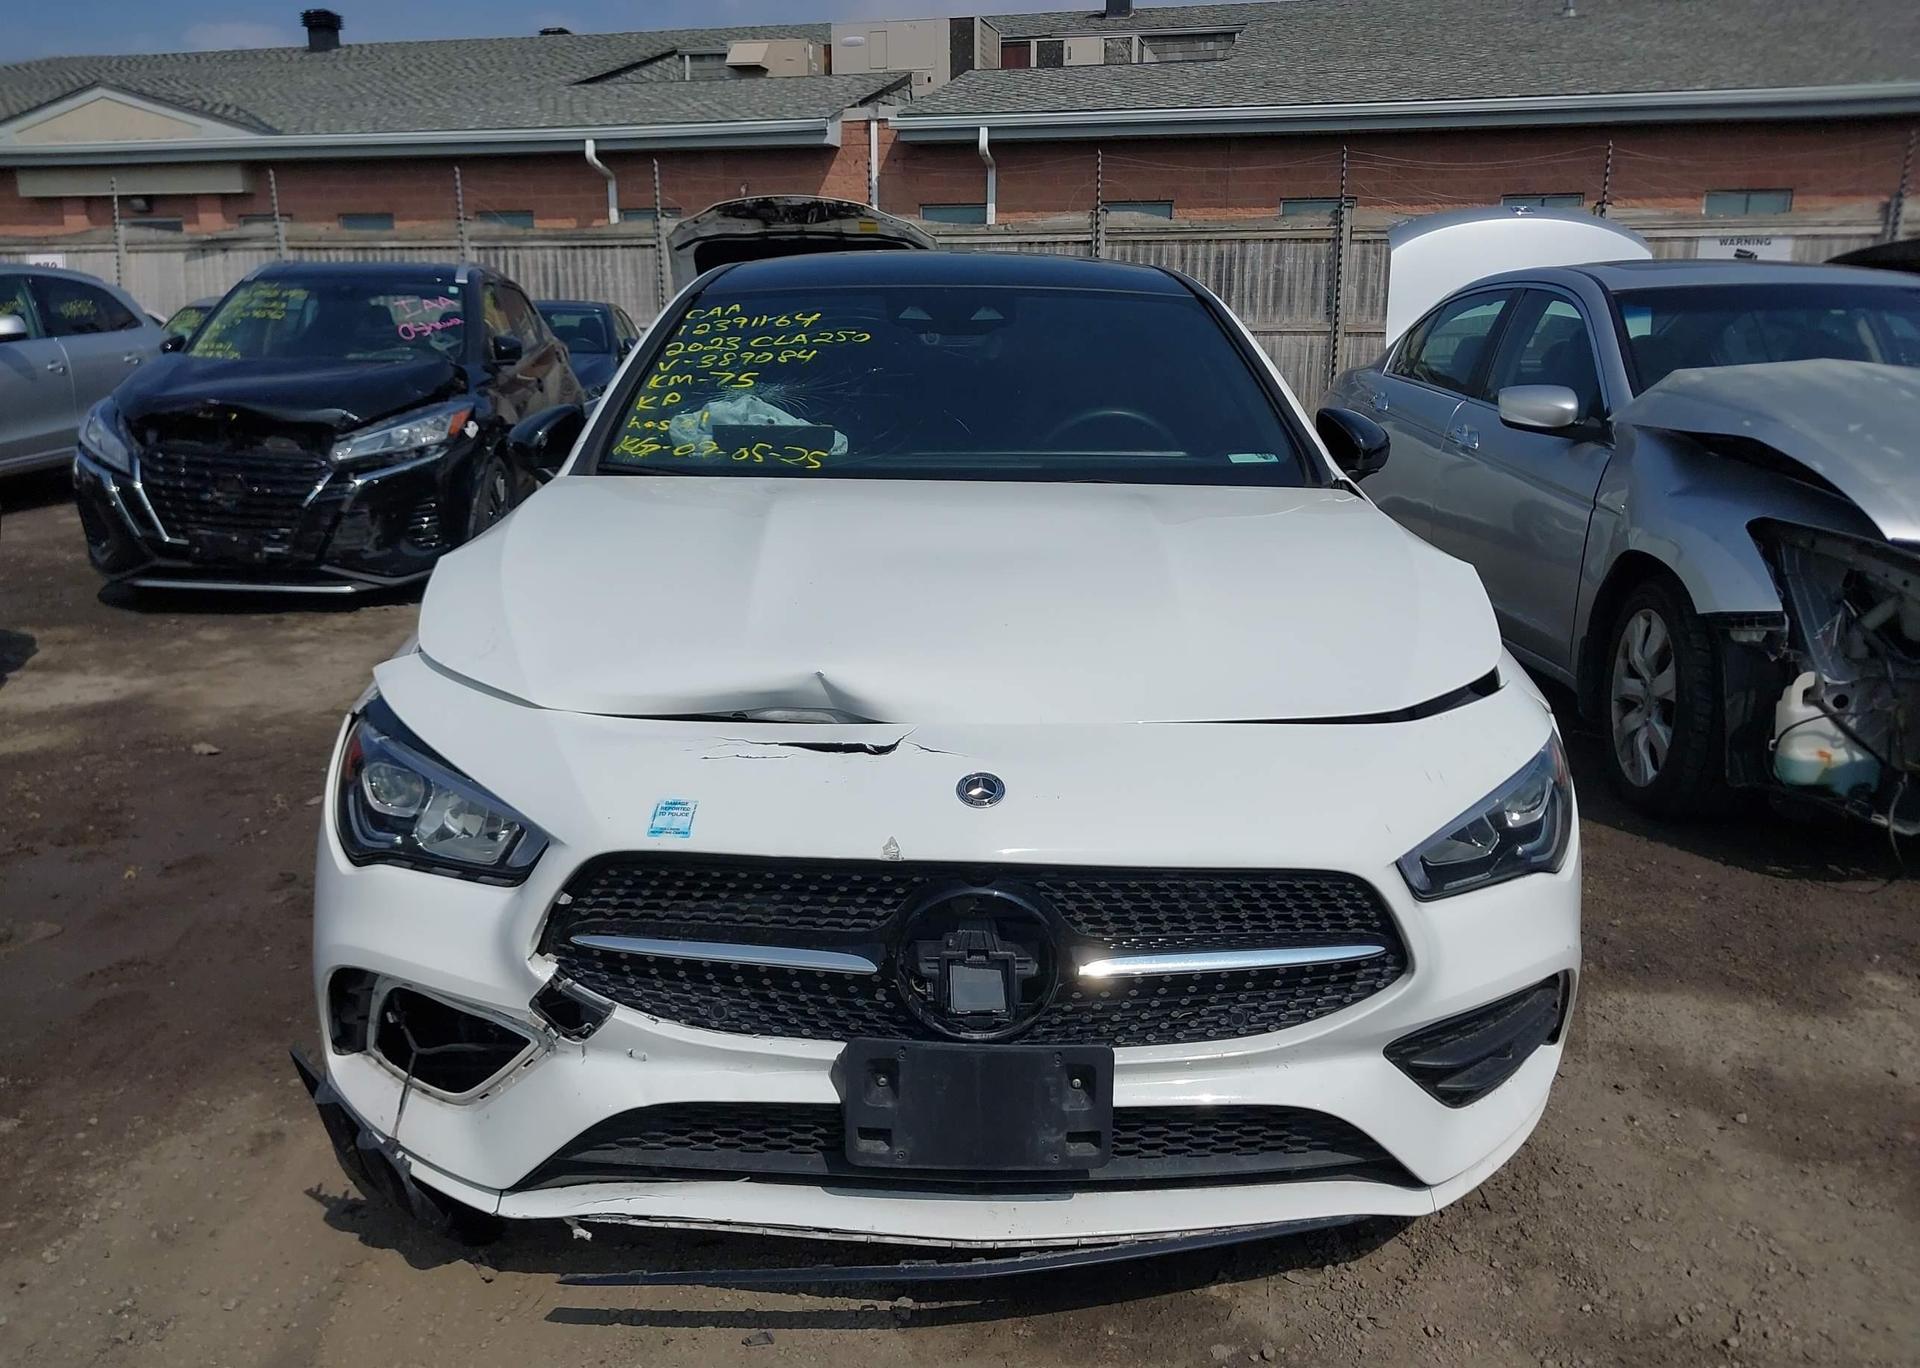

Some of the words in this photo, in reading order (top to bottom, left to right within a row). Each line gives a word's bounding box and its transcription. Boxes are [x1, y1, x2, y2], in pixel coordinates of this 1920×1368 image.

[1719, 238, 1772, 246] WARNING
[686, 304, 741, 320] CAA
[665, 336, 742, 357] 2023
